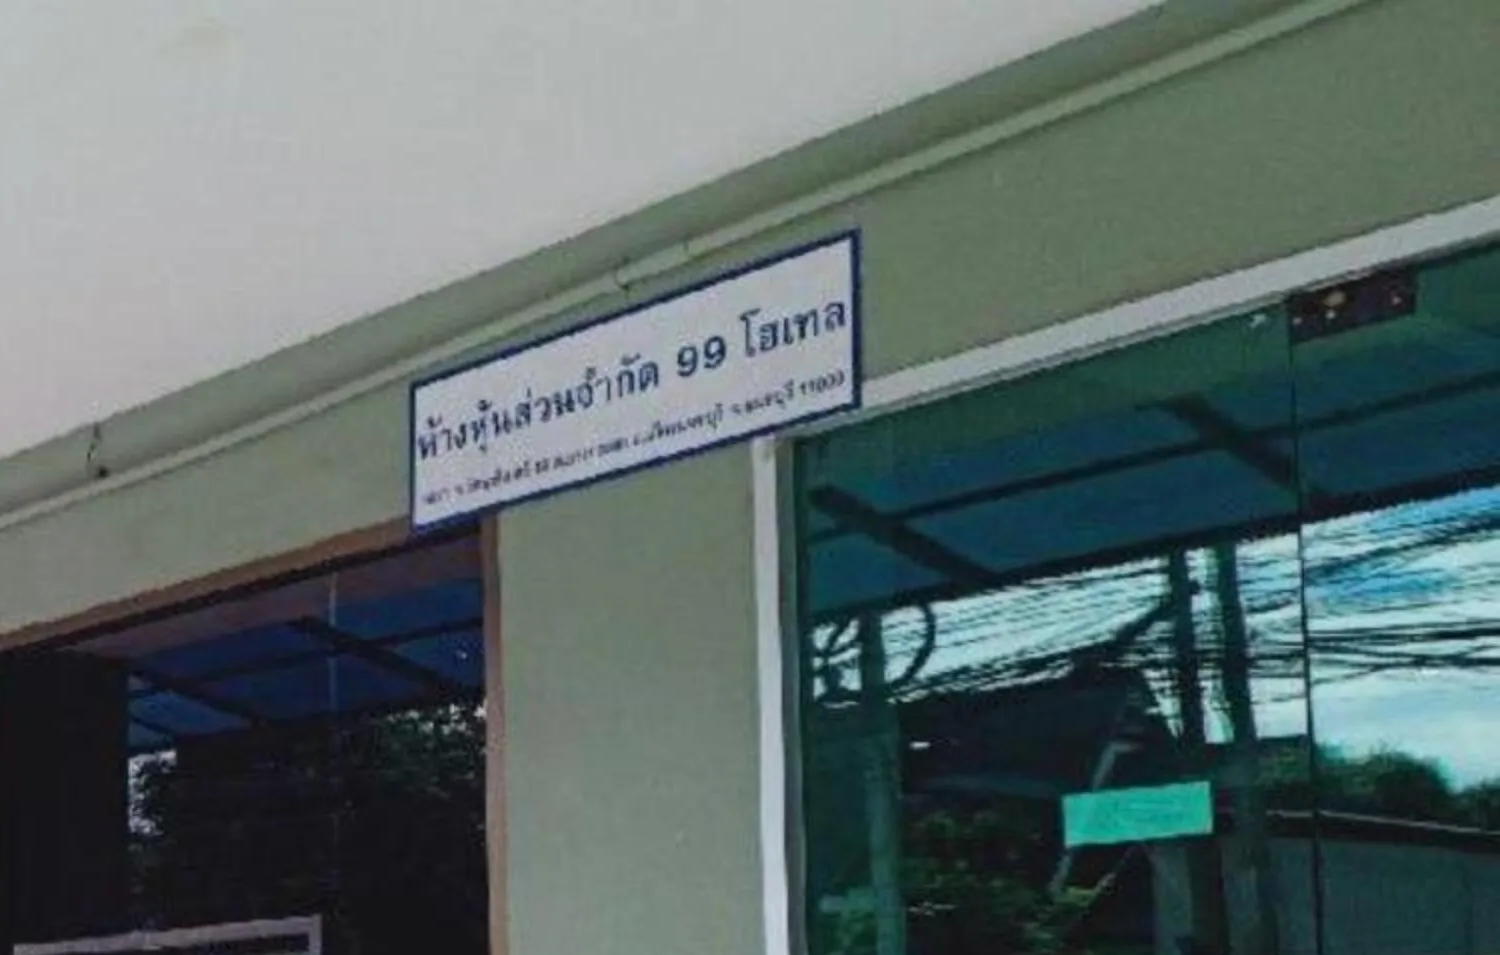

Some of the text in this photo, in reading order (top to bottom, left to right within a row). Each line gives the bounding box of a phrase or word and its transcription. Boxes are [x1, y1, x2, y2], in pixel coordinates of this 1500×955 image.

[417, 301, 846, 460] ห้างหุ้นส่วนจำกัด 99 โฮเทล
